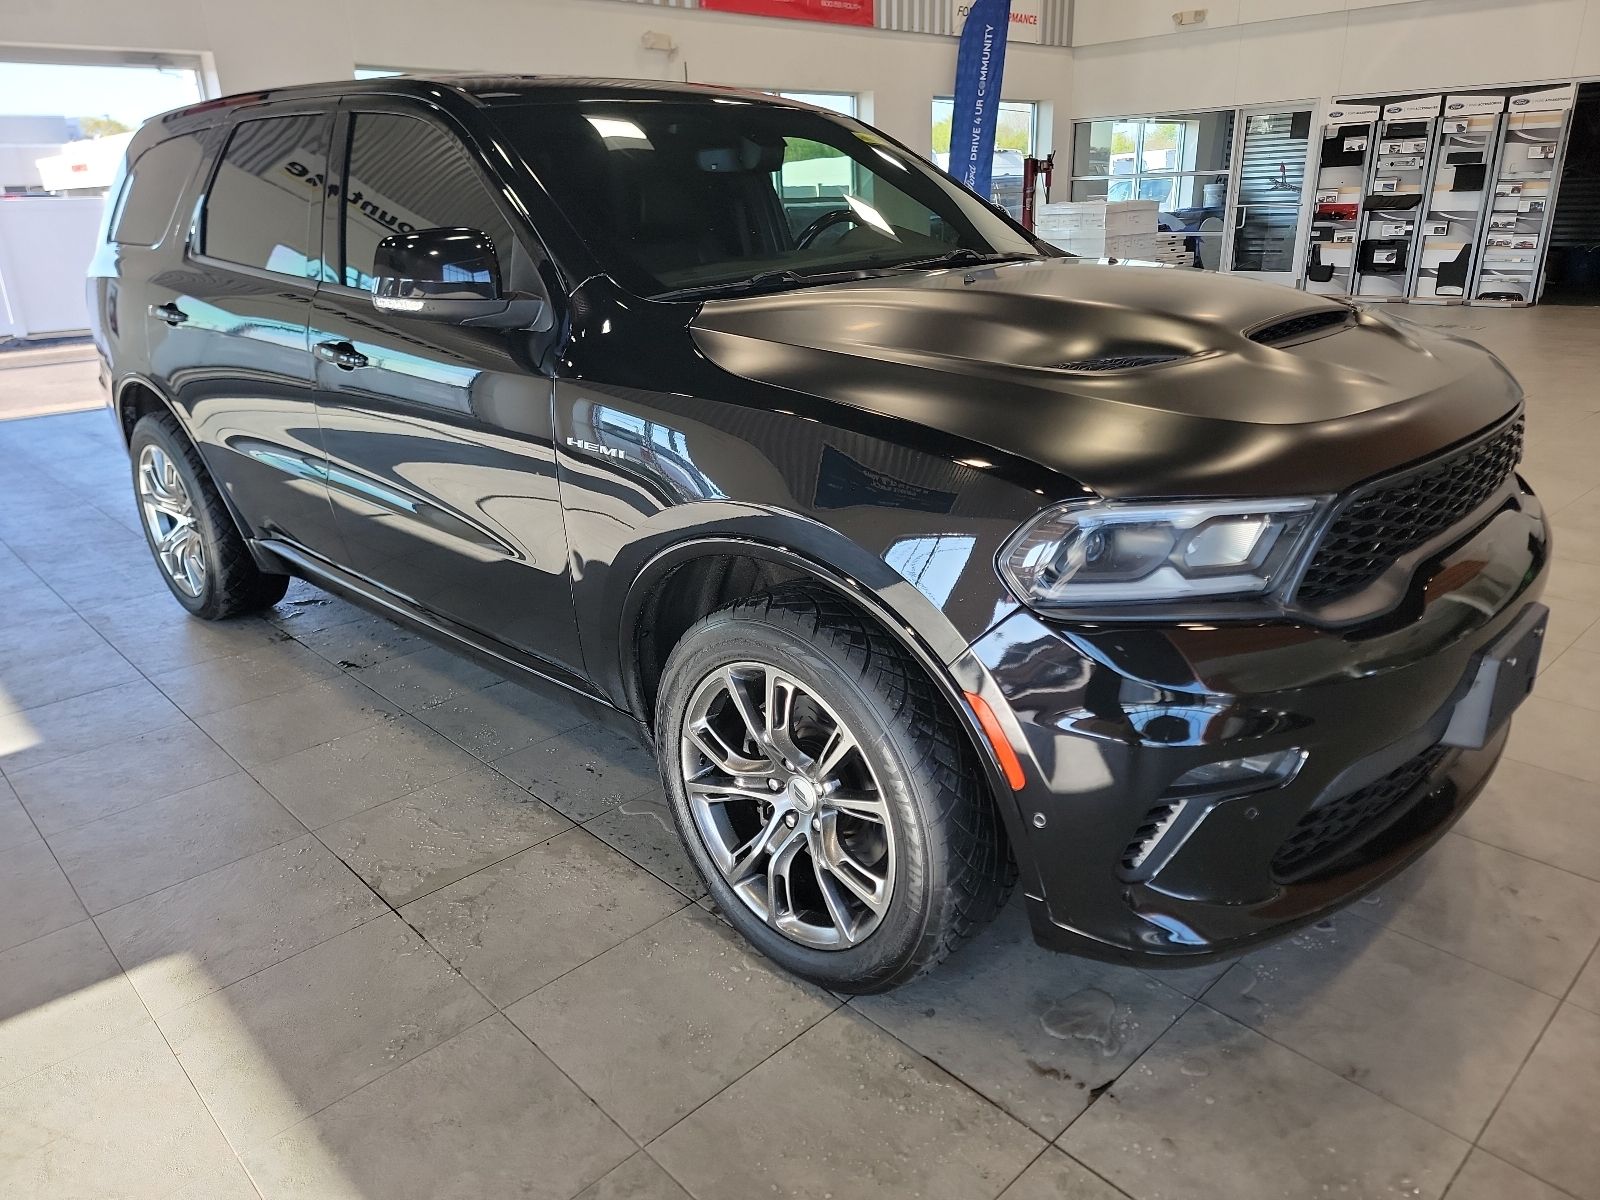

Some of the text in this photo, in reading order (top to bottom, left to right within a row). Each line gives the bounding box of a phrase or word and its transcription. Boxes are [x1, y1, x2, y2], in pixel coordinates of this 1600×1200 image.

[977, 24, 994, 96] COMMUNITY
[974, 100, 984, 116] UR
[970, 127, 982, 161] DRIVE
[566, 437, 626, 459] HEMI
